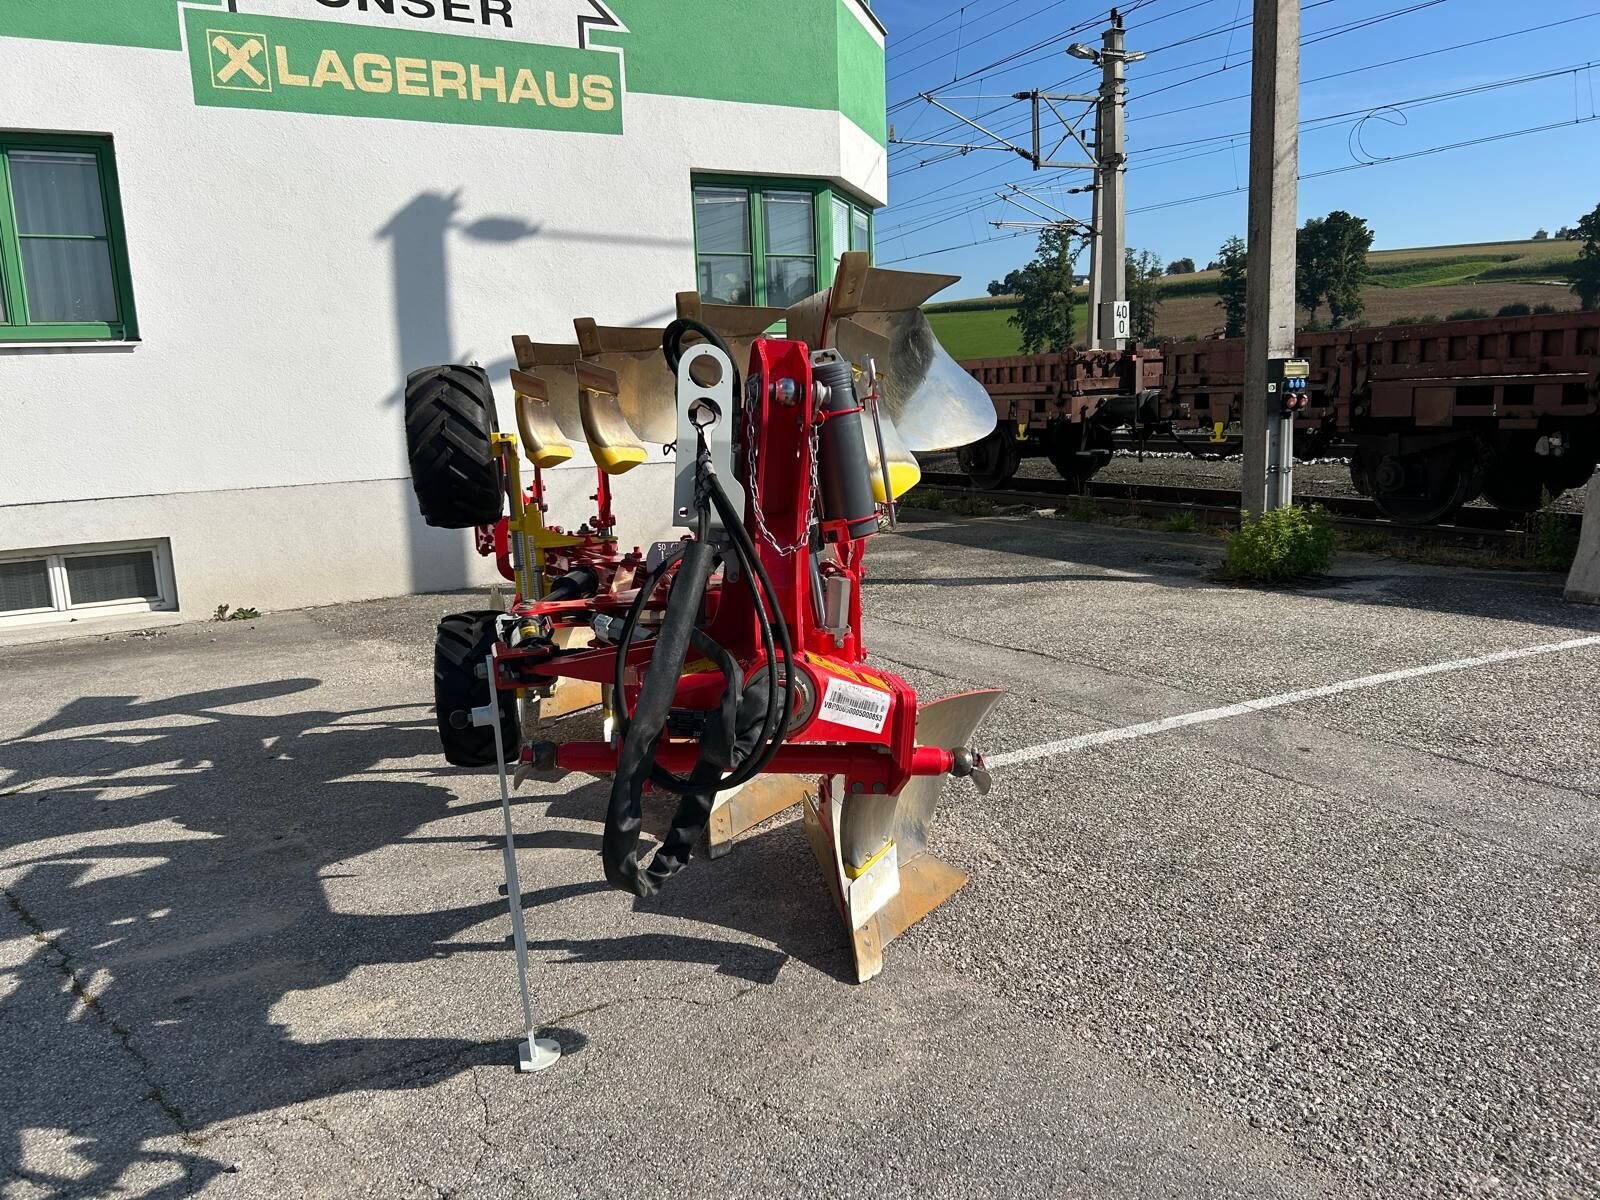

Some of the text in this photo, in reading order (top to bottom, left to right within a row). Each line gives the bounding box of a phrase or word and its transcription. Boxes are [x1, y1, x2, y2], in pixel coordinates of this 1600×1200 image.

[315, 0, 514, 28] NSER
[276, 45, 615, 111] LAGERHAUS
[1116, 305, 1128, 319] 40
[1119, 320, 1125, 334] 0
[657, 543, 666, 551] 50
